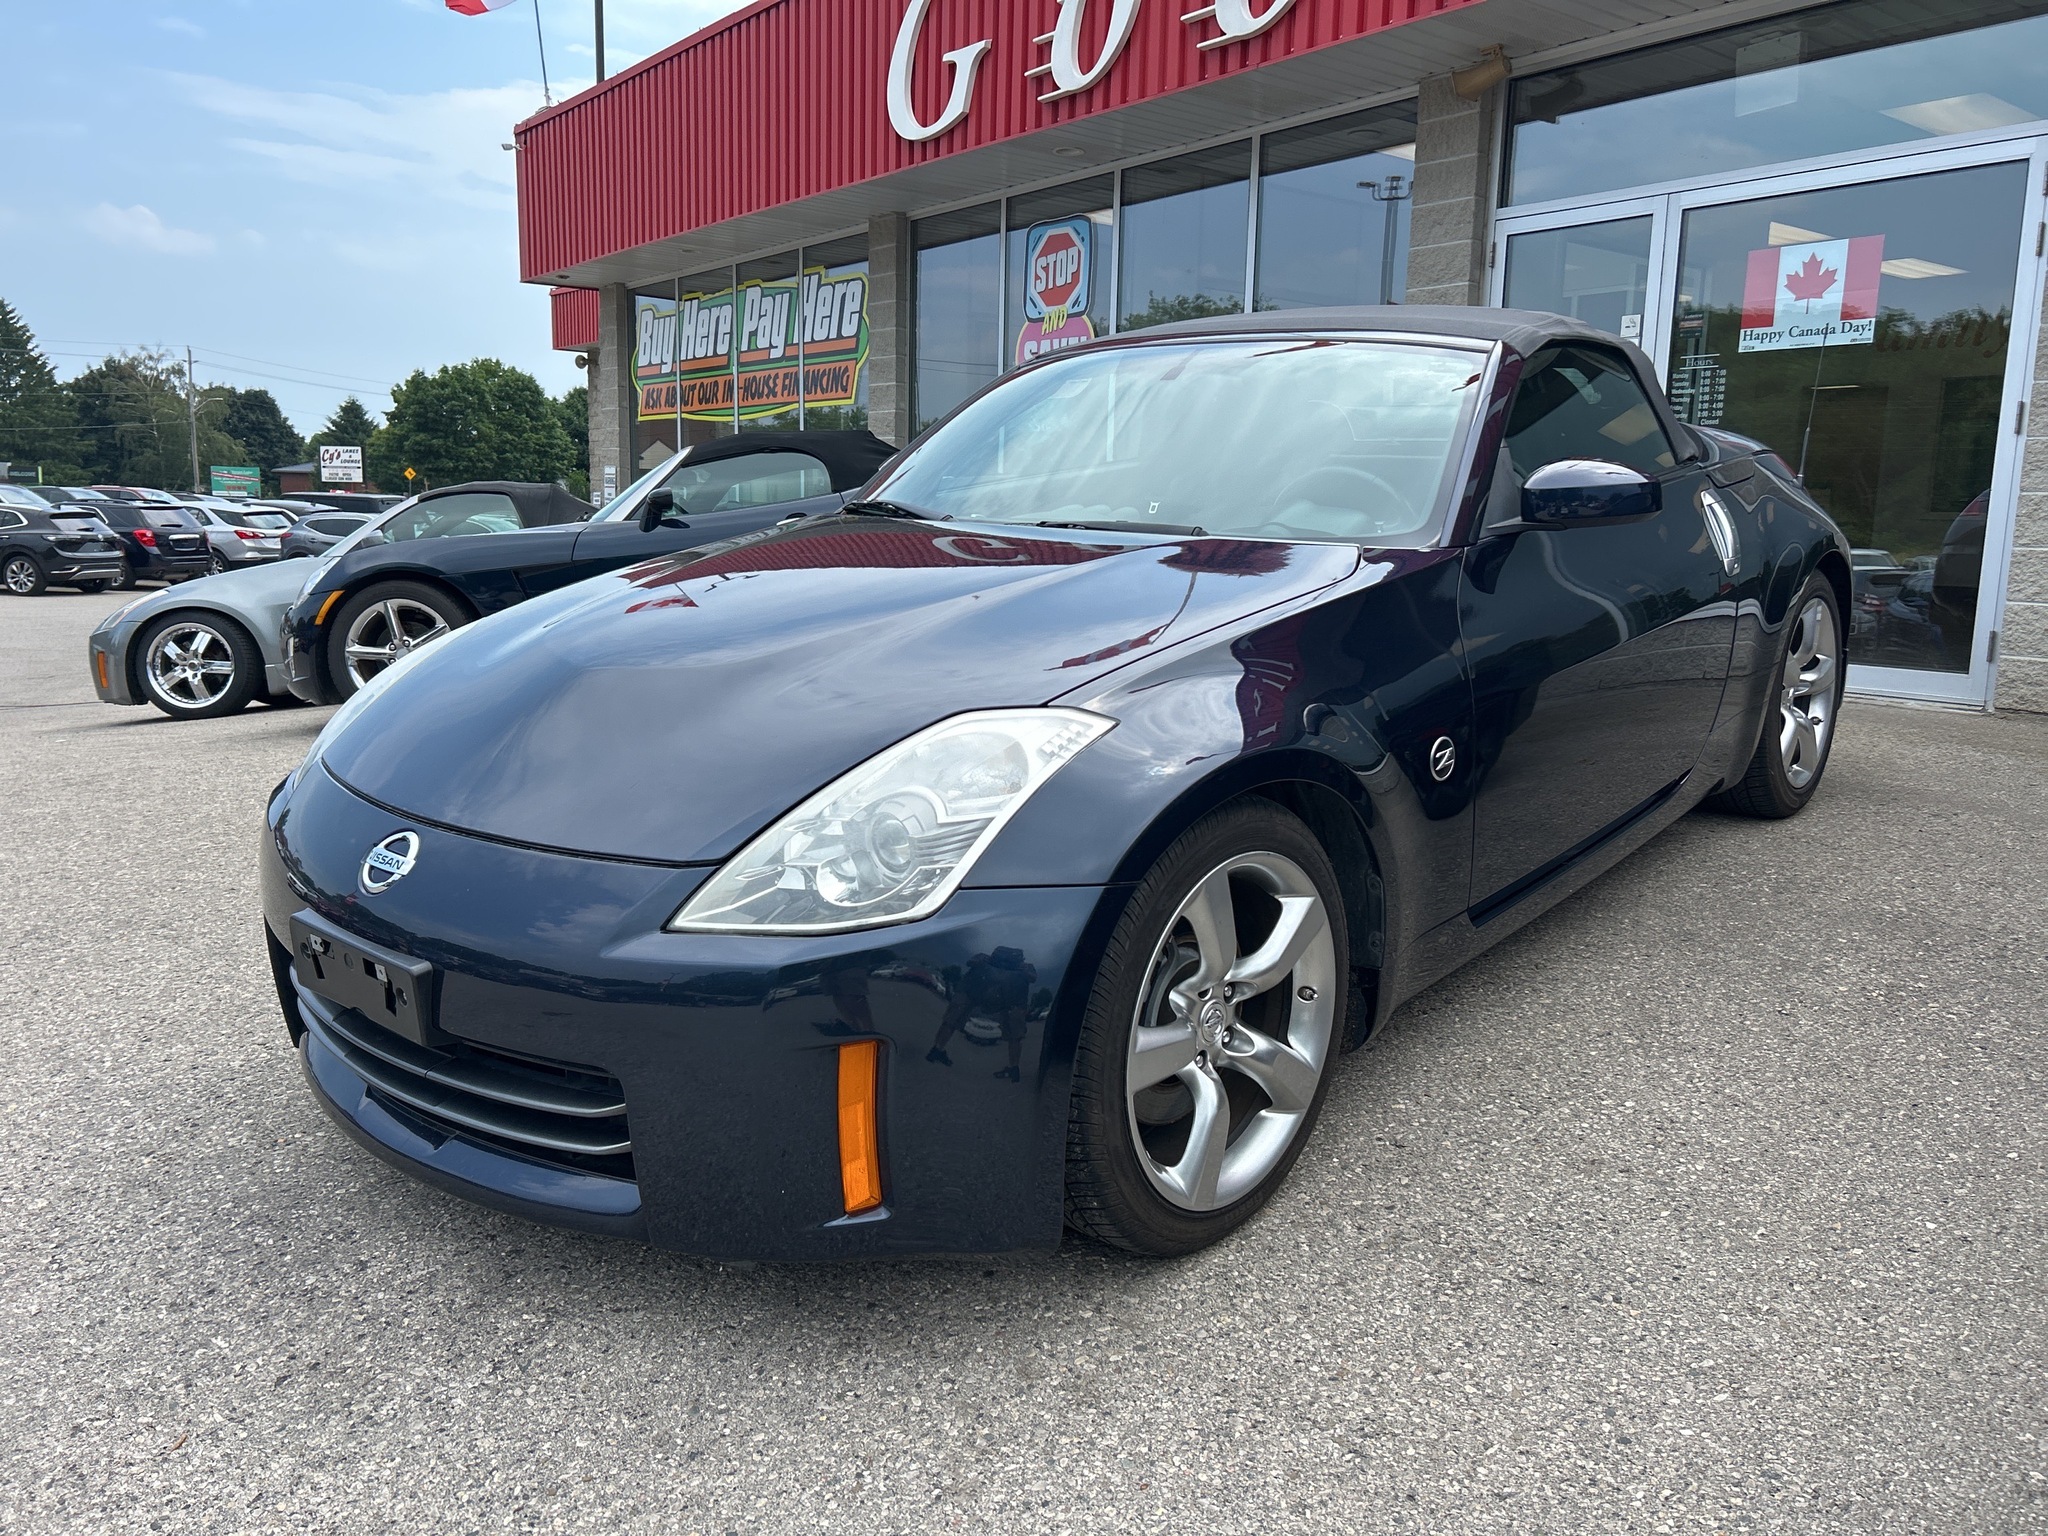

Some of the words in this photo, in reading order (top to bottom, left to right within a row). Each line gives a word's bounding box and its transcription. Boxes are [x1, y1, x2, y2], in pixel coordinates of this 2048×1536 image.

[1035, 246, 1078, 293] STOP
[638, 310, 676, 374] Buy
[680, 299, 732, 361] Here
[741, 286, 790, 358] Pay
[793, 274, 863, 344] Here
[1041, 306, 1067, 336] AND
[1743, 329, 1785, 344] Happy
[1788, 322, 1836, 338] Canada
[1841, 319, 1873, 336] Day!
[1685, 358, 1714, 367] Hours
[645, 387, 663, 410] ASK
[697, 380, 719, 405] OUR
[781, 365, 850, 398] FINANCING
[322, 449, 341, 464] Cy's
[369, 850, 405, 870] NISSAN
